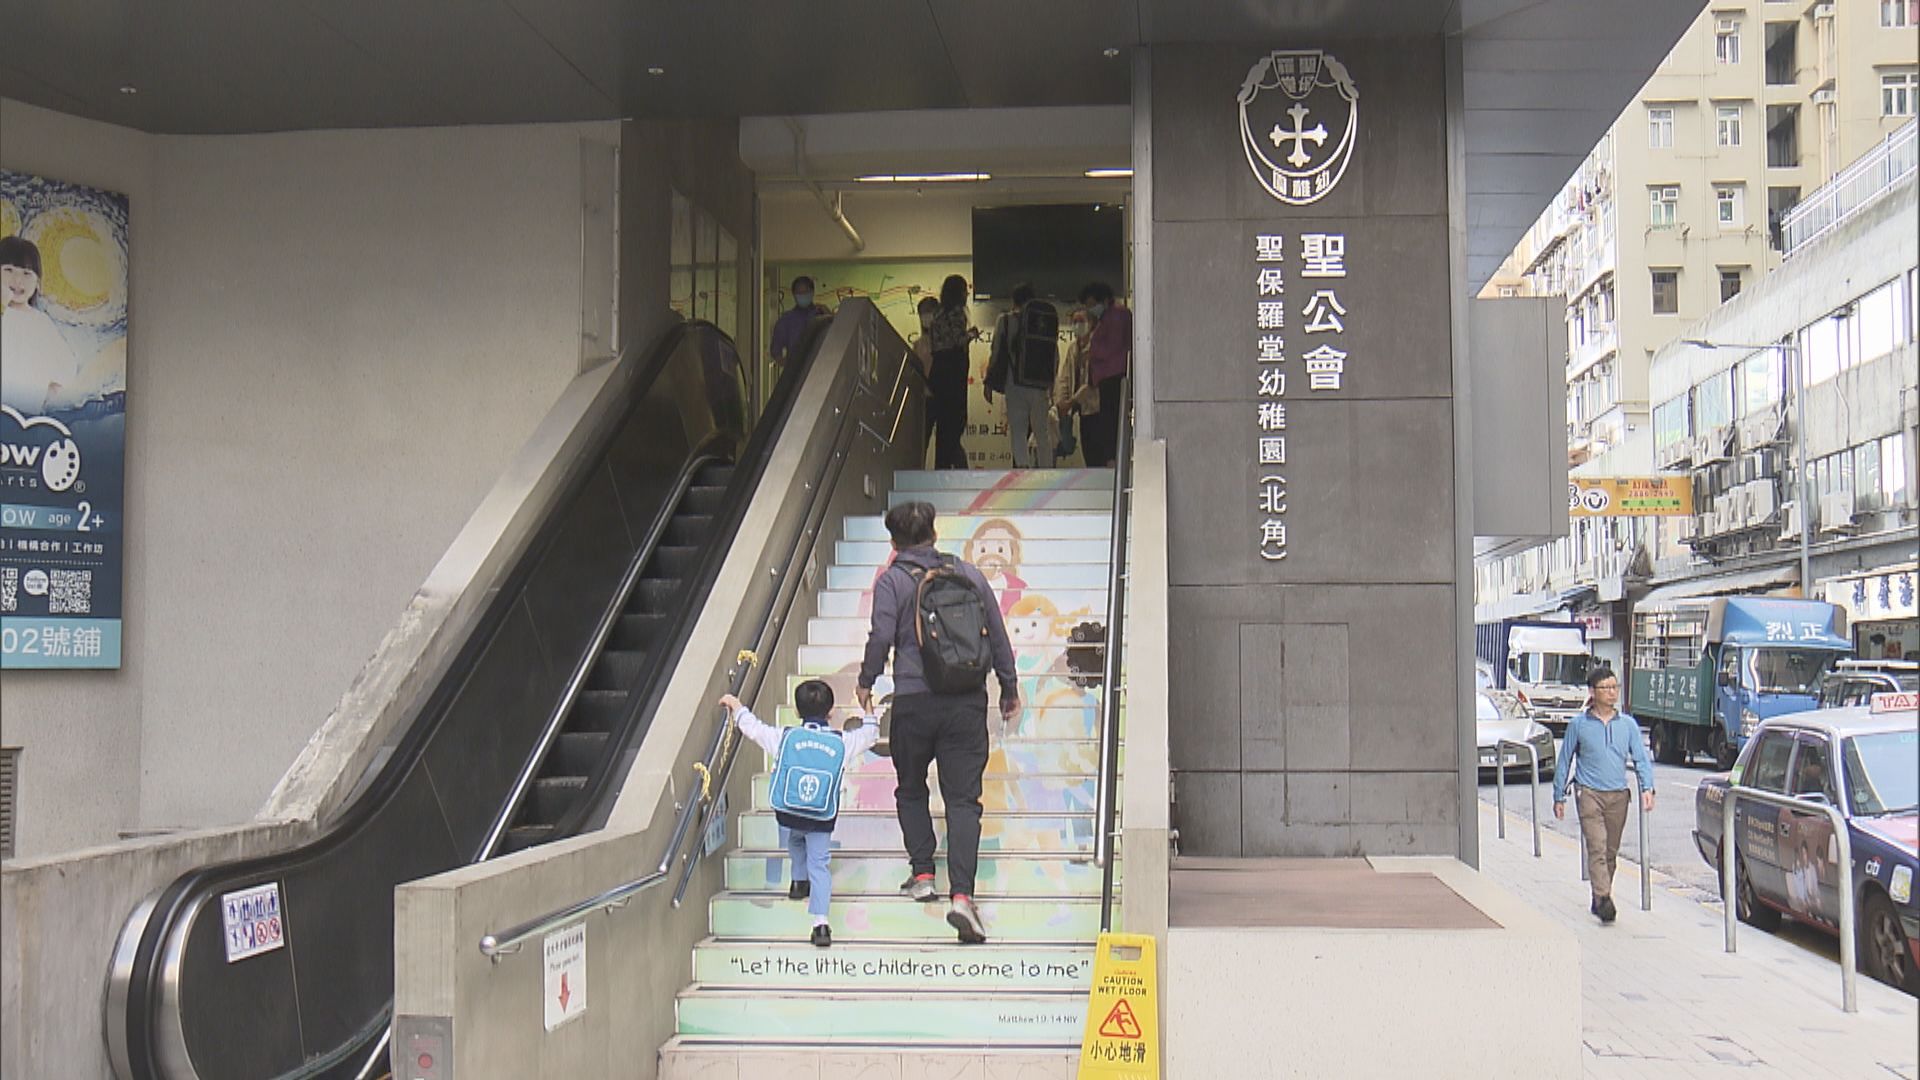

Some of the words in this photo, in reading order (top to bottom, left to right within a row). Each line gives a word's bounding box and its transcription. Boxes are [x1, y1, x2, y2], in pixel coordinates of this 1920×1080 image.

[1300, 234, 1347, 390] 聖公會
[48, 512, 72, 526] age
[77, 501, 104, 532] 2+
[730, 956, 772, 976] “Let
[776, 956, 810, 977] the
[815, 957, 858, 978] little
[862, 957, 947, 979] children
[952, 962, 1015, 980] come
[1020, 959, 1042, 979] to
[1097, 986, 1117, 995] WET
[1119, 987, 1148, 997] FLOOR
[1103, 975, 1144, 986] CAUTION
[998, 1014, 1034, 1025] Matthew
[1063, 1014, 1078, 1025] NIV
[1090, 1039, 1147, 1063] 小心地滑
